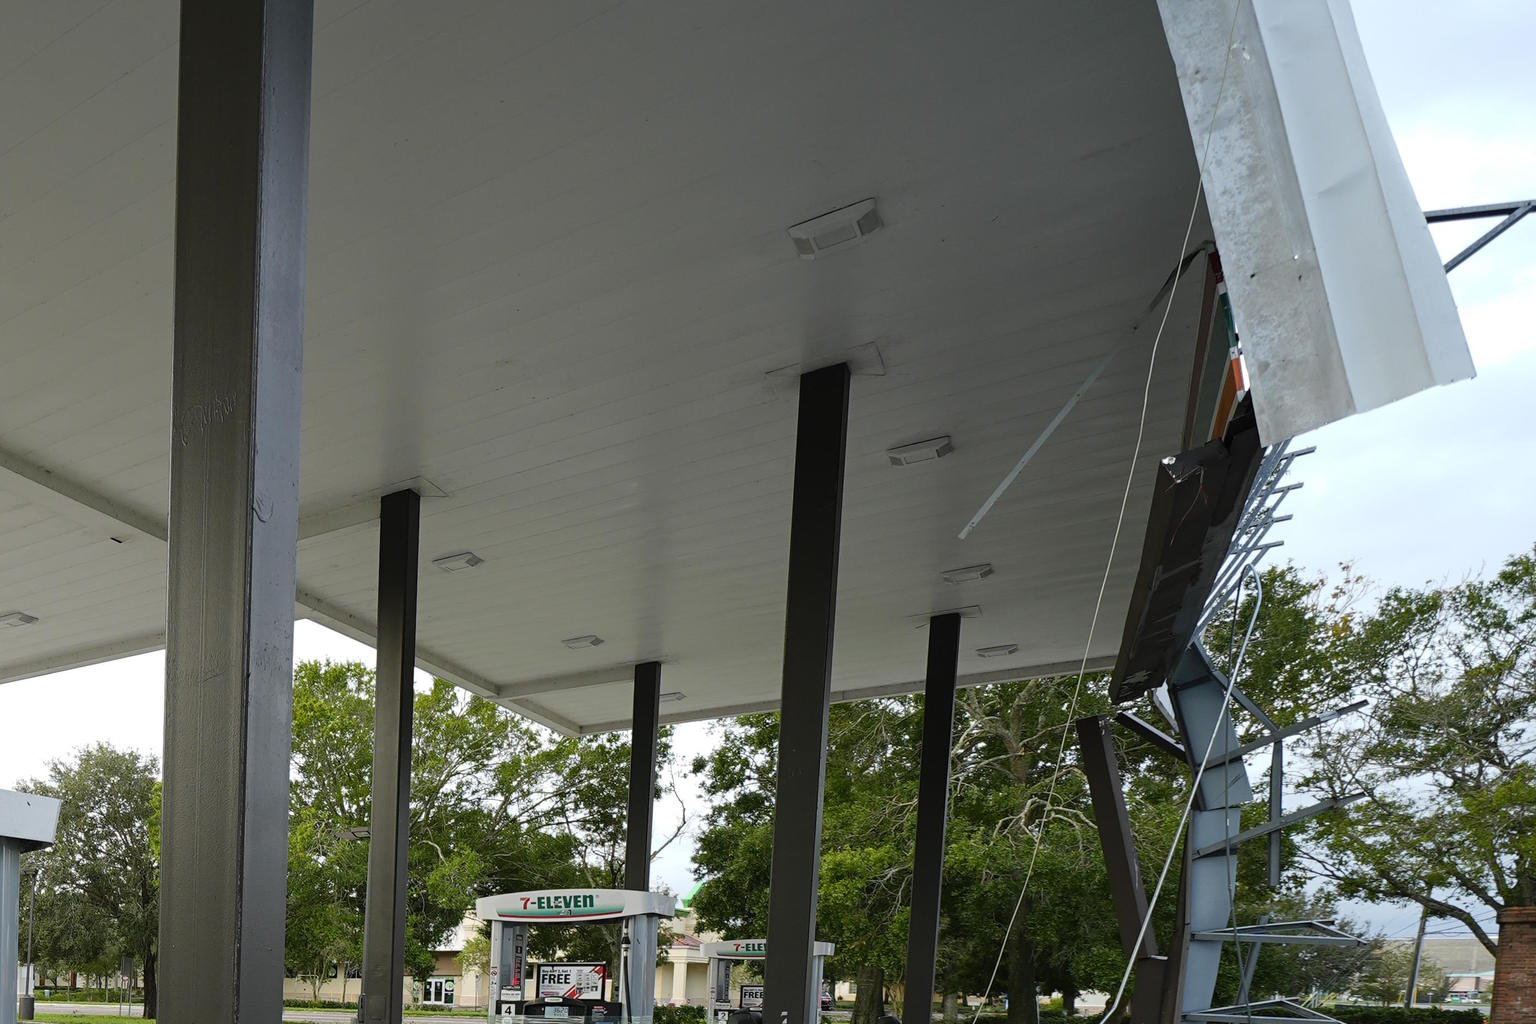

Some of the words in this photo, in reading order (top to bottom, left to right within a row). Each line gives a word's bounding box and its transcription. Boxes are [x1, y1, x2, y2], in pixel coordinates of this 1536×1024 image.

[734, 943, 767, 952] 7-ELE
[541, 973, 571, 984] FREE
[504, 1005, 512, 1015] 4
